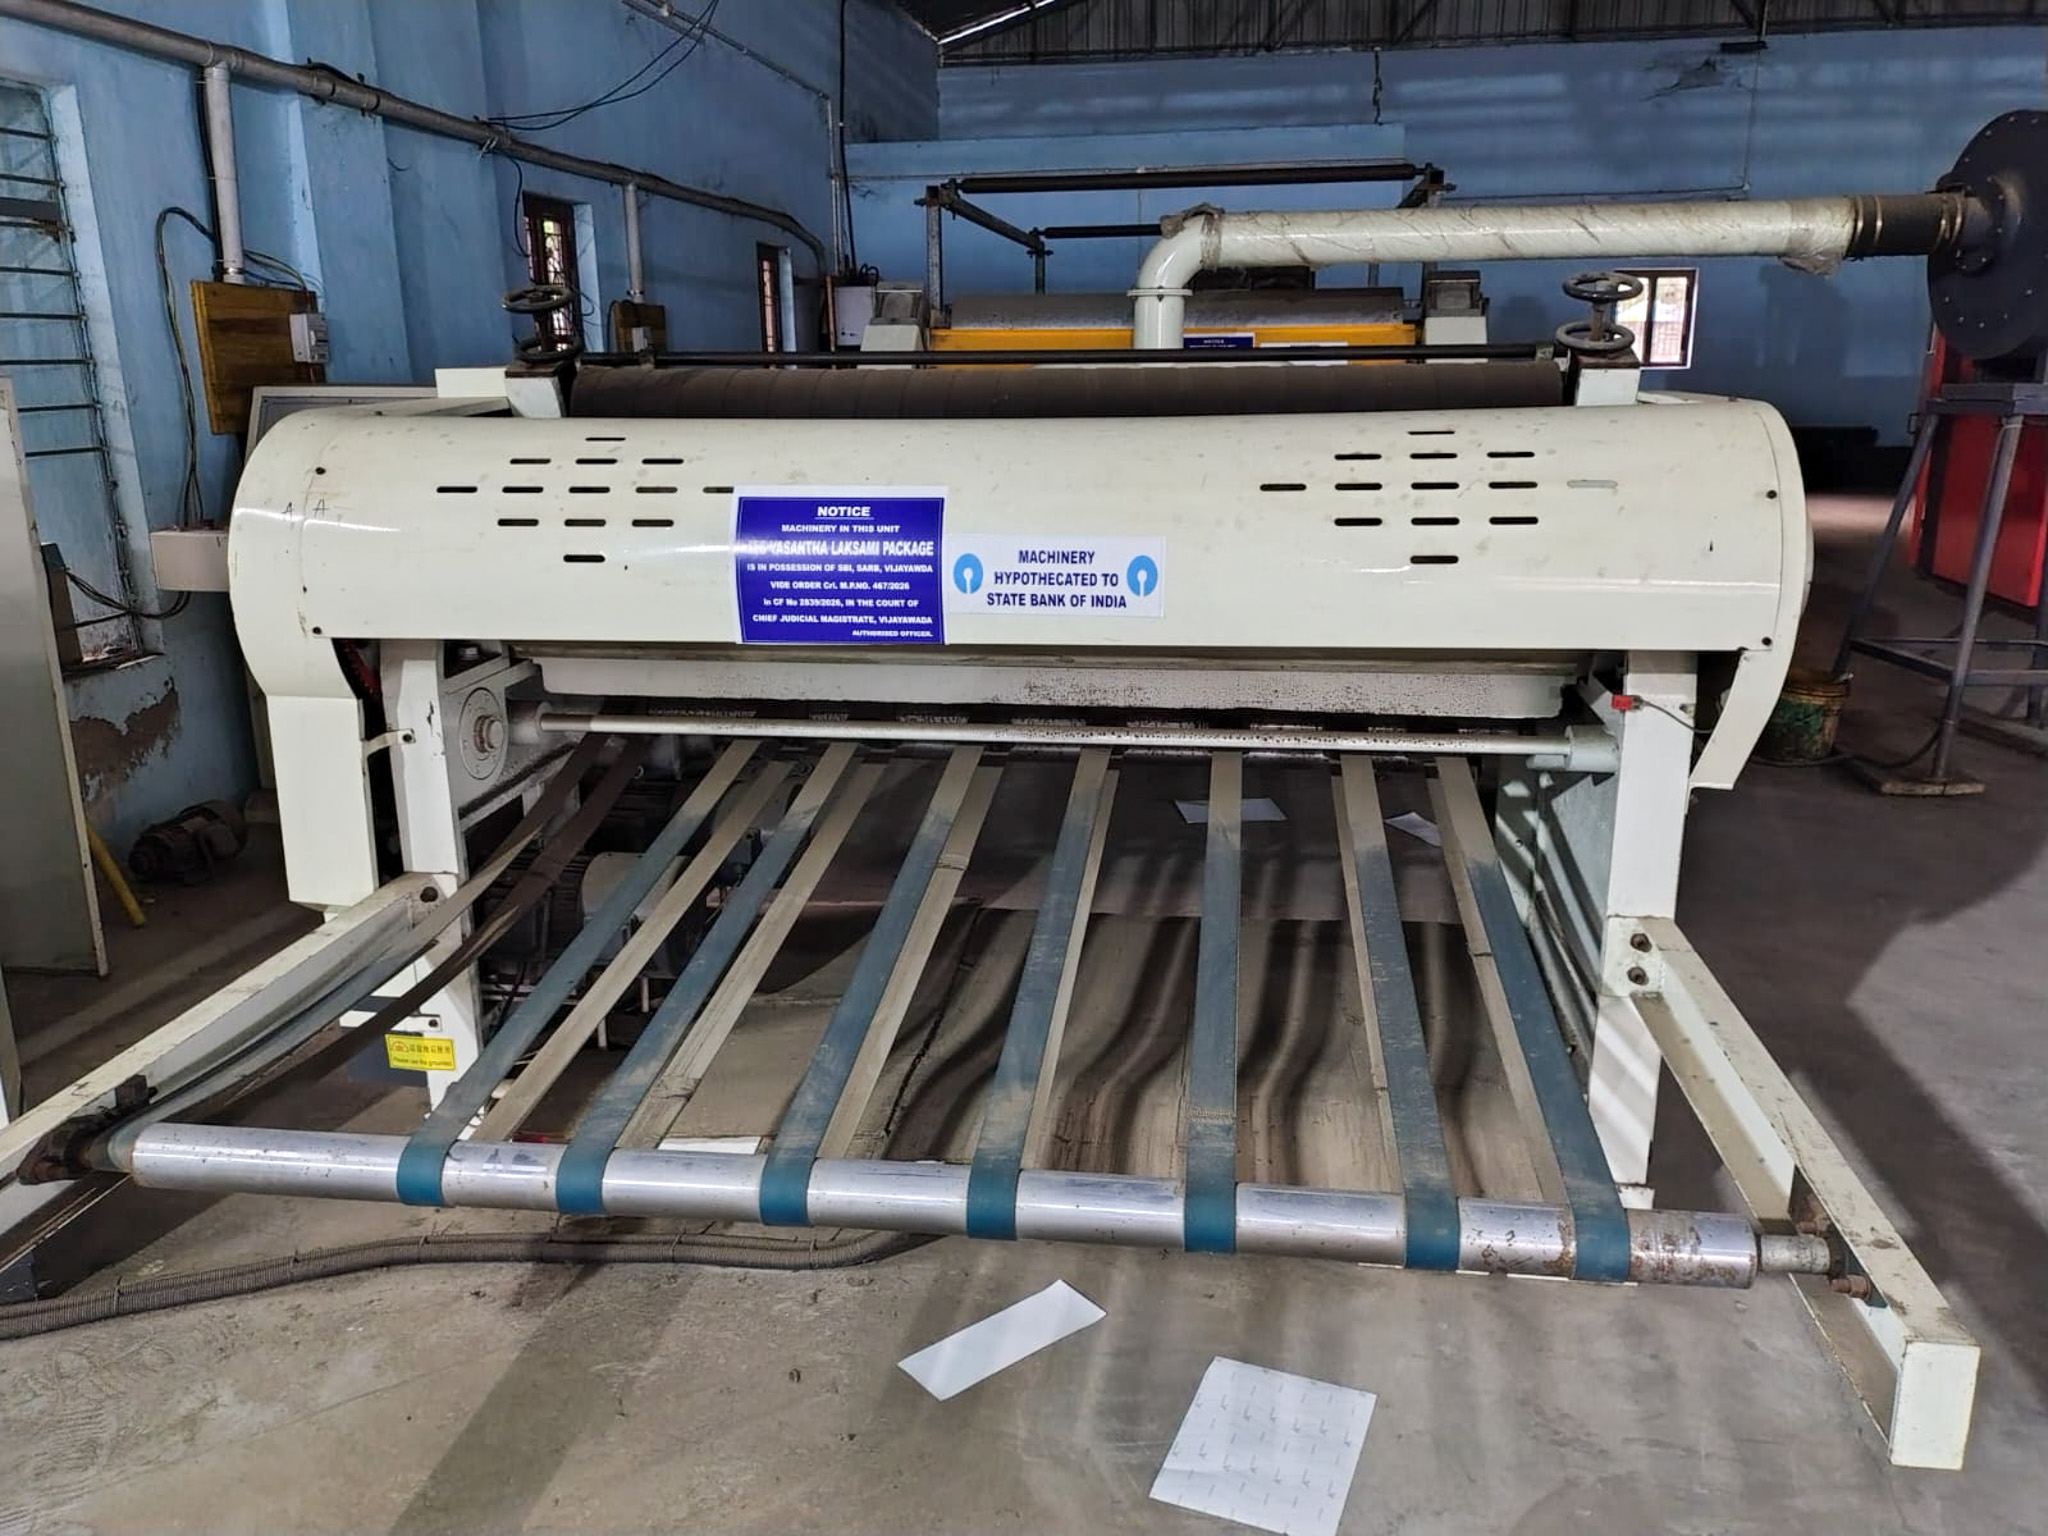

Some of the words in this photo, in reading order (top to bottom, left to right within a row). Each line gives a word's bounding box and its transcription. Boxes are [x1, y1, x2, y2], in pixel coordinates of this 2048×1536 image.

[817, 506, 871, 517] NOTICE
[781, 524, 837, 532] MACHINERY
[839, 525, 850, 533] IN
[852, 525, 875, 533] THIS
[877, 525, 900, 533] UNIT
[831, 540, 880, 556] LAKSAMI
[882, 541, 934, 556] PACKAGE
[1018, 549, 1095, 565] MACHINERY
[747, 563, 756, 571] IS
[757, 563, 767, 571] IN
[769, 563, 822, 571] POSSESSION
[824, 564, 836, 572] OF
[770, 580, 790, 589] VIDE
[792, 581, 822, 589] ORDER
[994, 571, 1098, 587] HYPOTHECATED
[1101, 573, 1119, 587] TO
[845, 599, 855, 607] IN
[856, 599, 874, 607] THE
[876, 599, 905, 608] COURT
[907, 600, 919, 608] OF
[987, 592, 1026, 607] STATE
[1030, 593, 1066, 608] BANK
[1070, 594, 1087, 608] OF
[1091, 594, 1127, 609] INDIA
[752, 614, 778, 622] CHIEF
[779, 614, 819, 623] JUDICIAL
[820, 615, 877, 625] MAGISTRATE,
[878, 616, 933, 624] VIJAYAWADA
